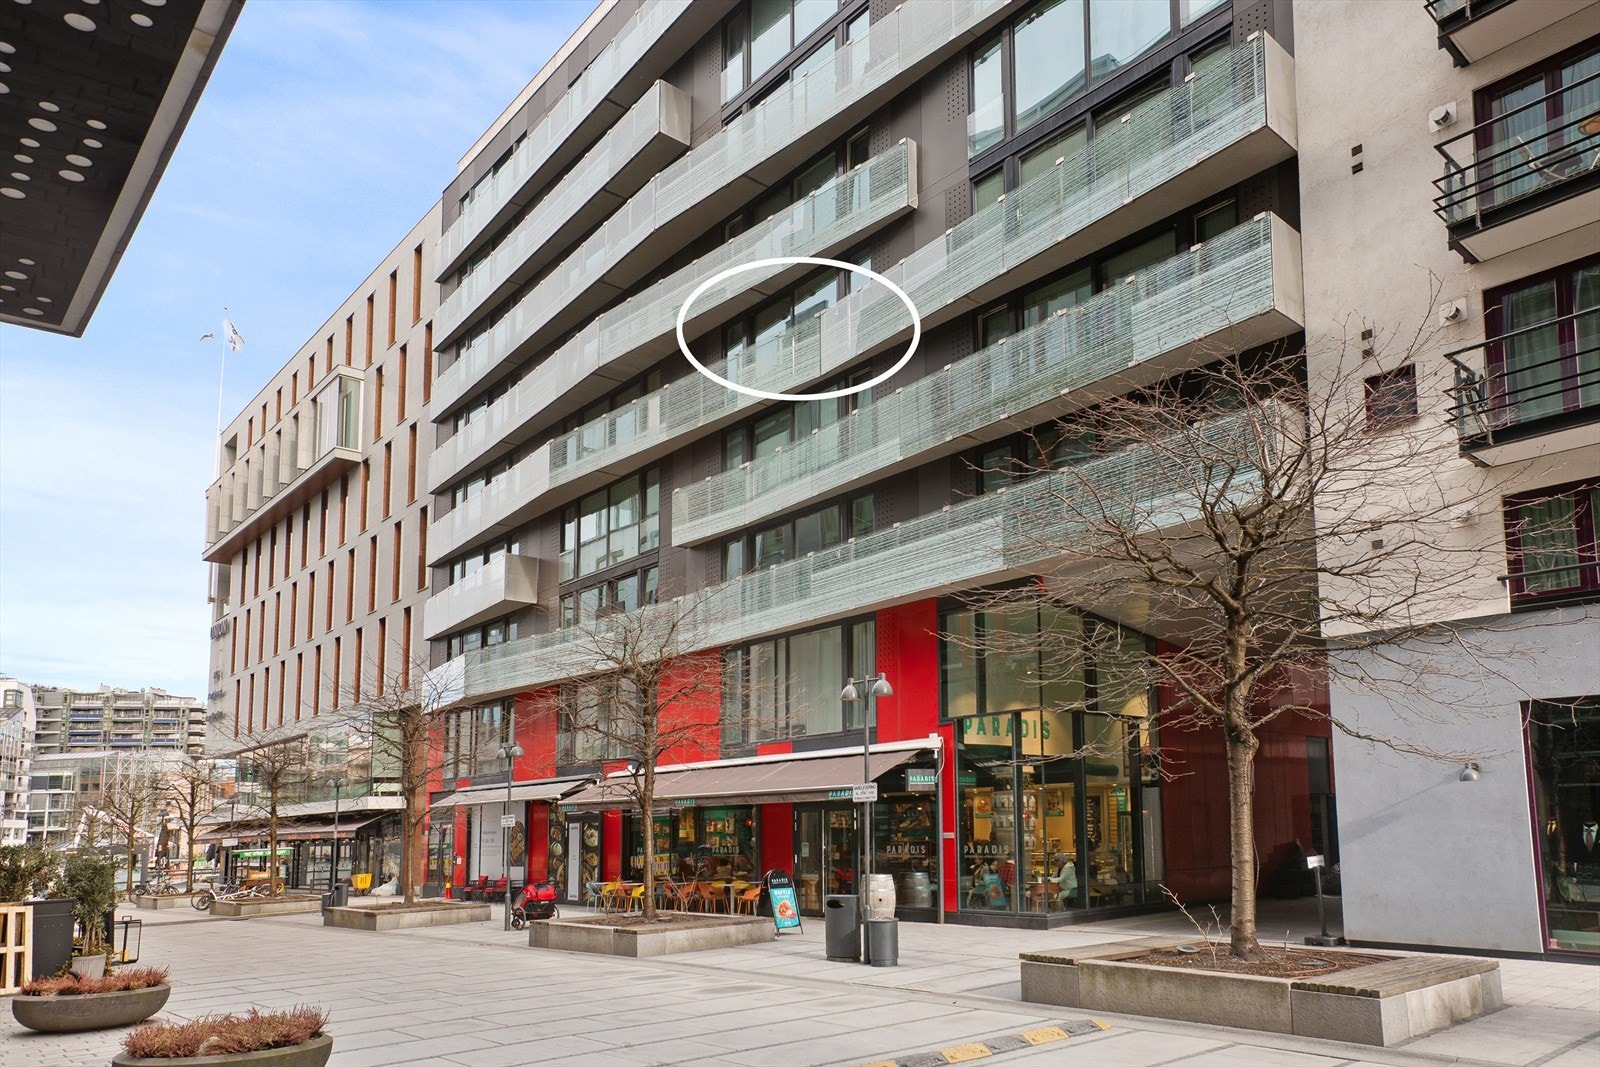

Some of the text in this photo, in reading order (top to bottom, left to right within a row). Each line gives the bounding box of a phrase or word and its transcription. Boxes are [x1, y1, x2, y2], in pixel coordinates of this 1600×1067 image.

[964, 716, 1051, 739] PARADIS
[909, 775, 935, 783] PARADIS
[712, 846, 740, 854] PARADIS
[886, 845, 926, 854] PARADIS
[963, 845, 1010, 855] PARADIS
